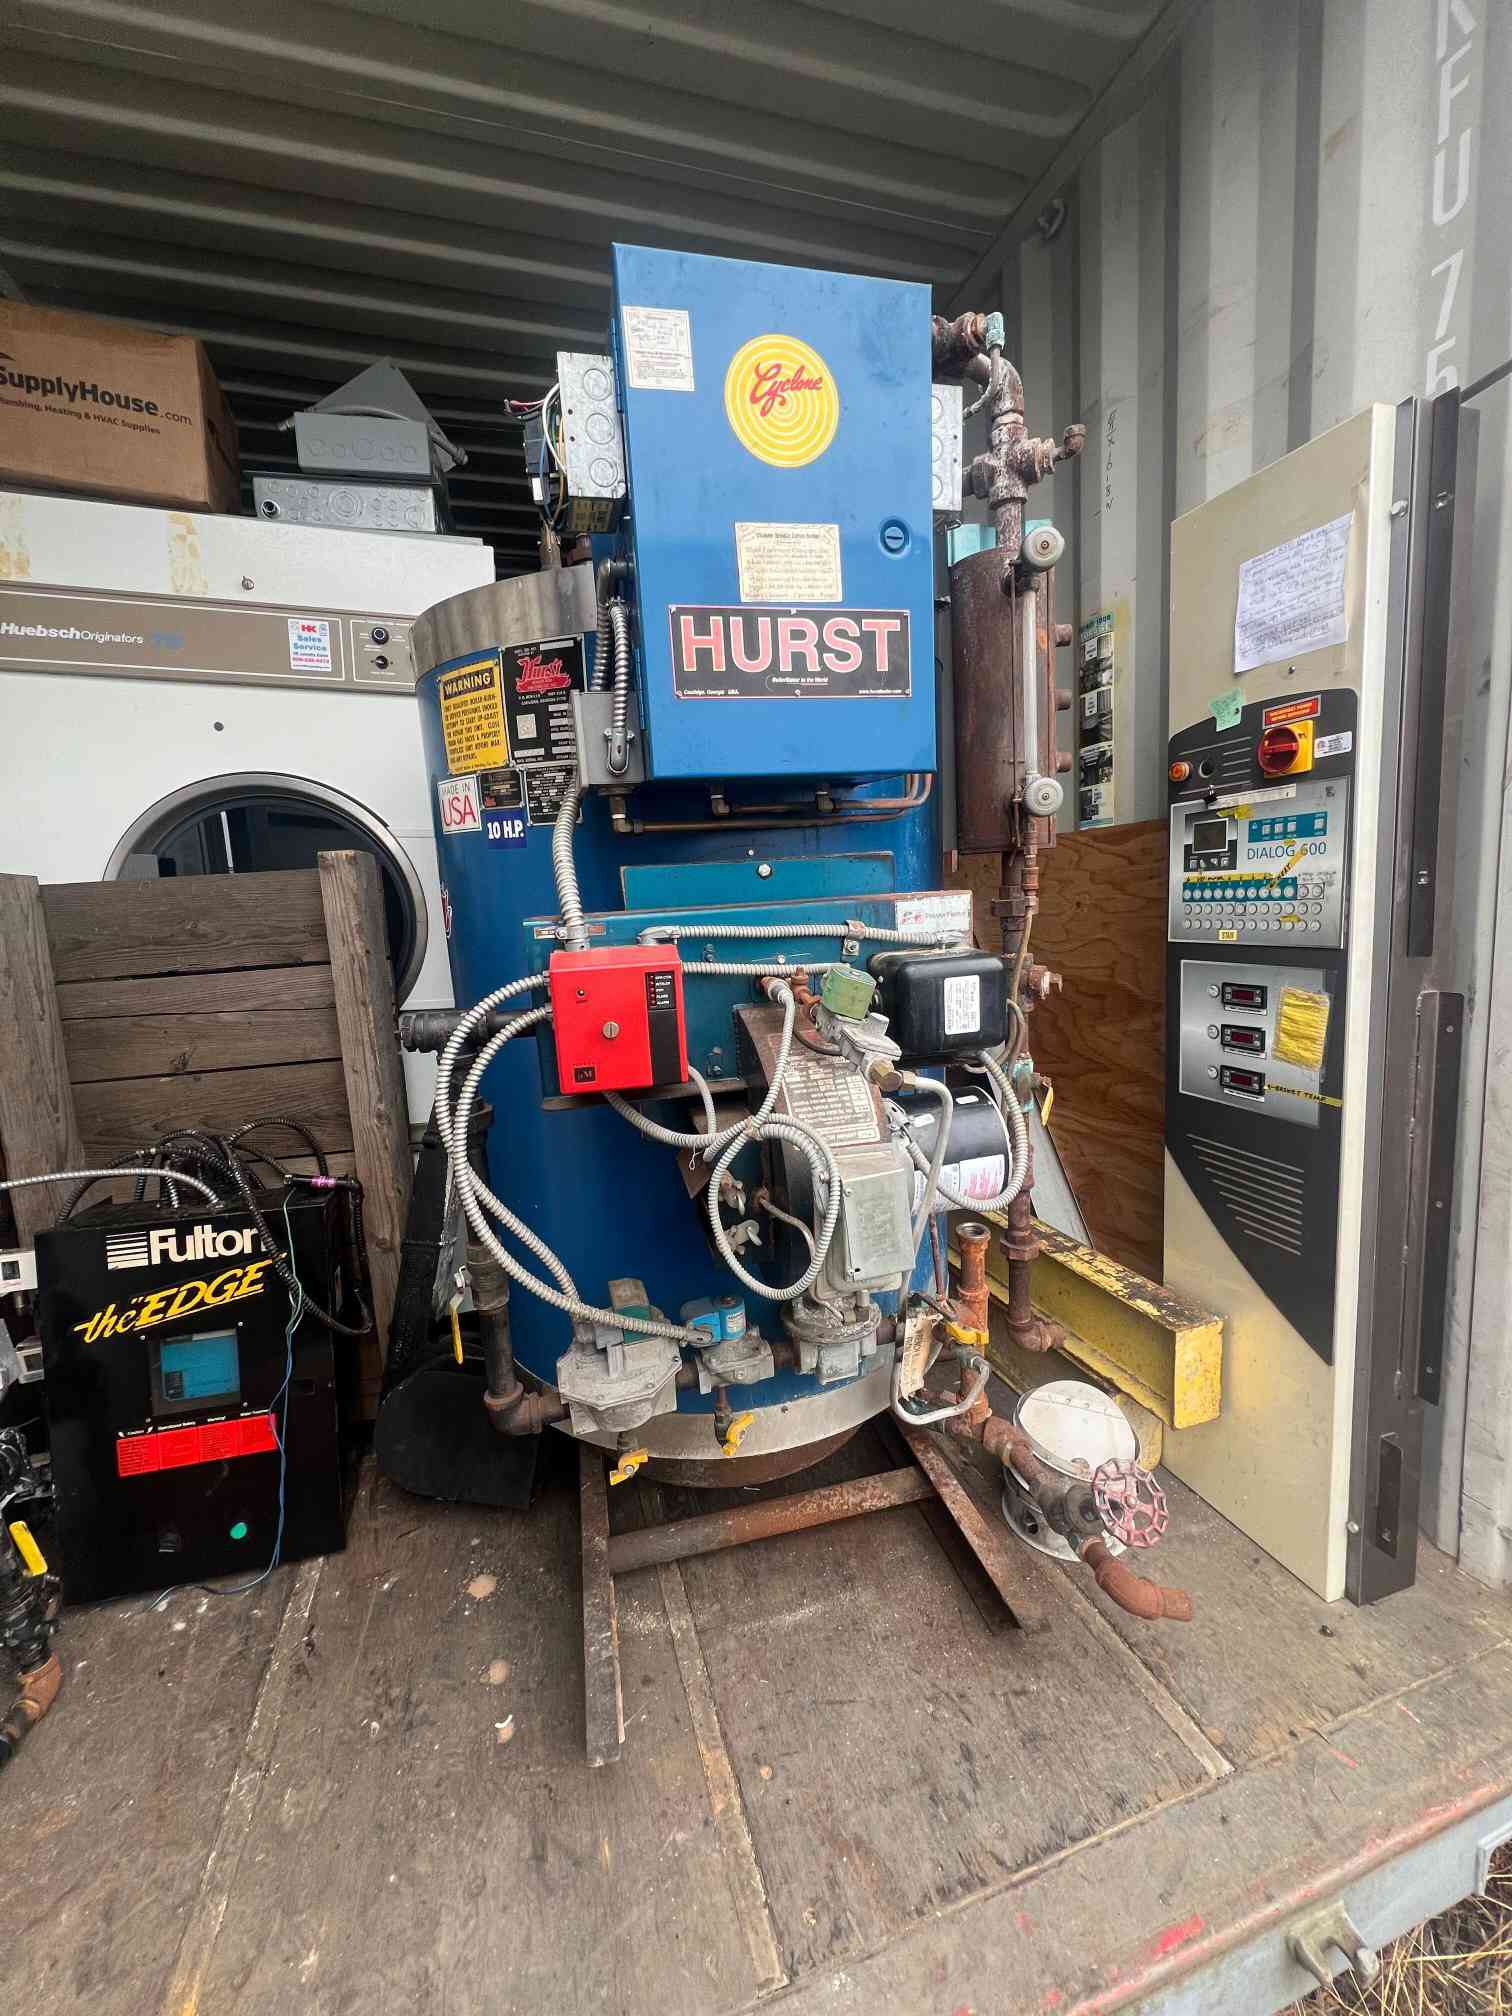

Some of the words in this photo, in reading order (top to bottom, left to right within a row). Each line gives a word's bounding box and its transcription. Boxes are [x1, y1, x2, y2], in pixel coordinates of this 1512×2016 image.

[750, 362, 823, 417] Cyclone
[84, 412, 91, 420] &
[93, 414, 119, 426] HVAC
[297, 635, 322, 643] Sales
[301, 624, 317, 633] HK
[293, 642, 327, 652] Service
[680, 615, 901, 673] HURST
[516, 655, 568, 682] Hurst
[445, 673, 491, 696] WARNING
[442, 784, 459, 796] MADE
[460, 782, 471, 793] IN
[442, 795, 477, 827] USA
[487, 821, 501, 840] 10
[503, 819, 525, 839] H.P.
[1247, 845, 1296, 860] DIALOG
[1300, 842, 1327, 856] 600
[74, 1303, 139, 1344] the
